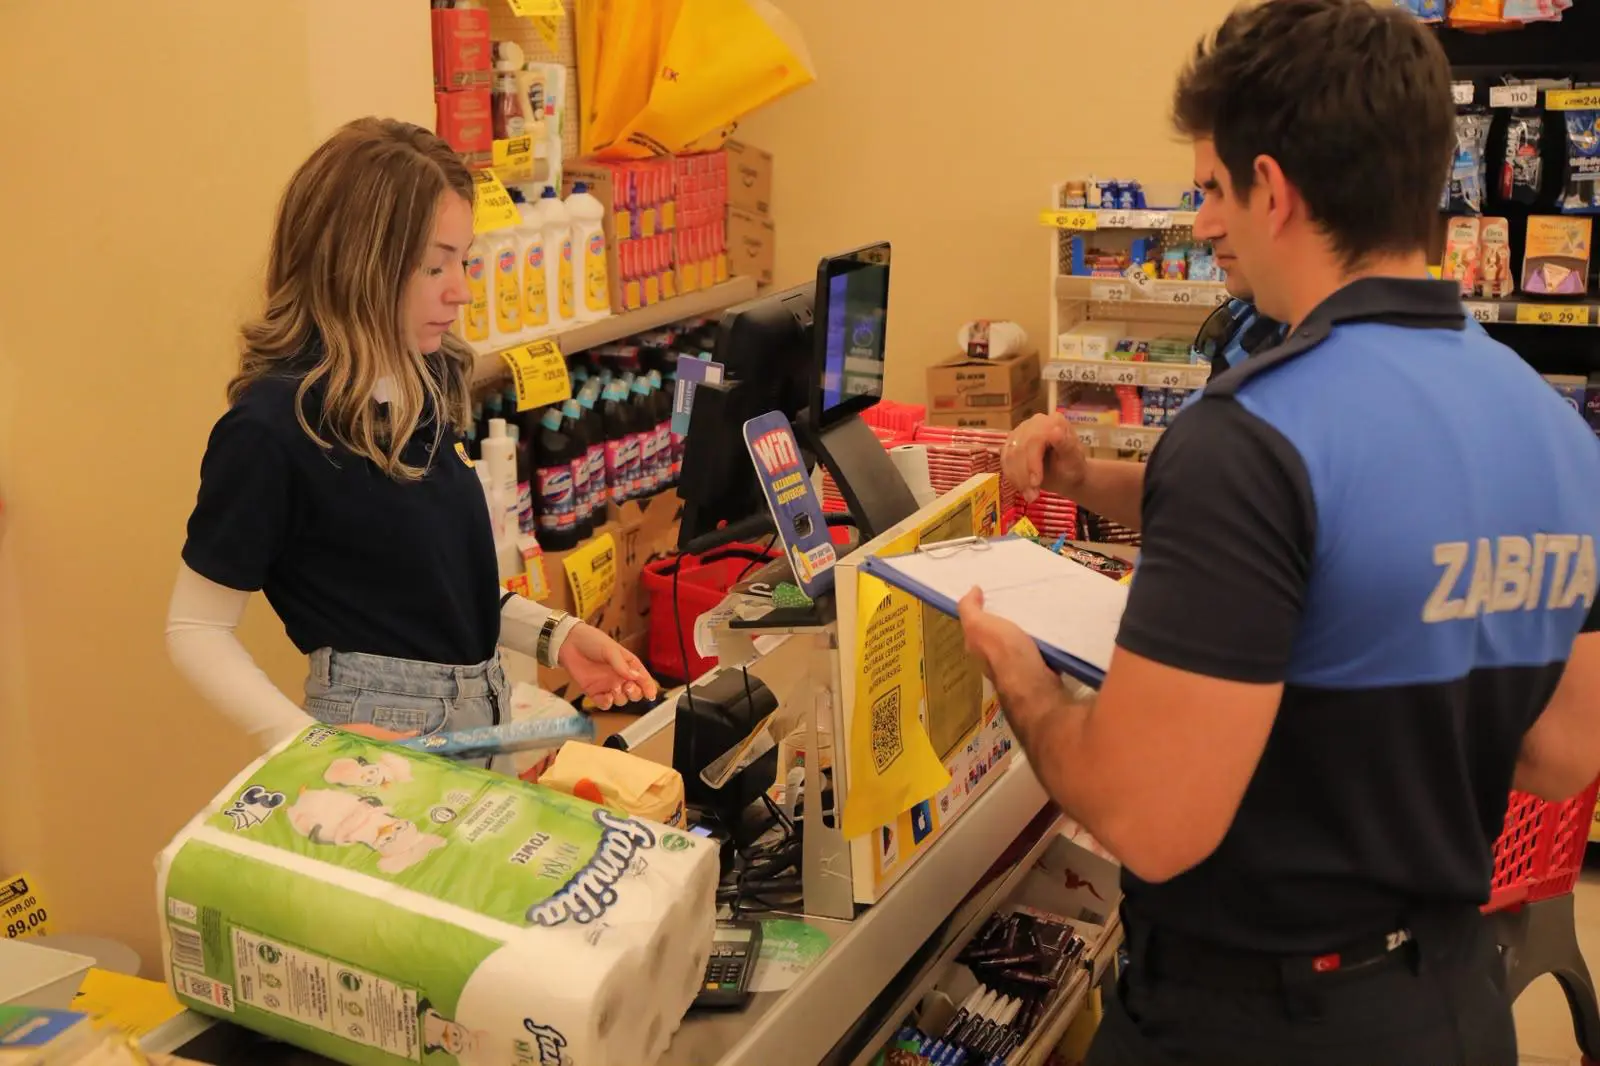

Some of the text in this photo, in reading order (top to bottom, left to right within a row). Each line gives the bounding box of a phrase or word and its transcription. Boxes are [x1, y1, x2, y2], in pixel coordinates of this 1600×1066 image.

[1511, 92, 1528, 101] 110
[1072, 217, 1086, 227] 49
[1109, 216, 1125, 225] 44
[1109, 289, 1123, 299] 22
[1173, 292, 1190, 302] 60
[1474, 311, 1489, 321] 85
[1559, 312, 1574, 322] 29
[1058, 368, 1073, 379] 63
[1082, 369, 1096, 380] 63
[1118, 372, 1133, 383] 49
[1163, 375, 1178, 386] 49
[1125, 438, 1141, 448] 40
[754, 430, 798, 476] Win
[1422, 533, 1597, 623] ZABITA
[511, 831, 551, 865] TOWEL
[526, 808, 656, 927] Familia
[5, 895, 37, 919] 199,00
[7, 908, 47, 938] 89,00
